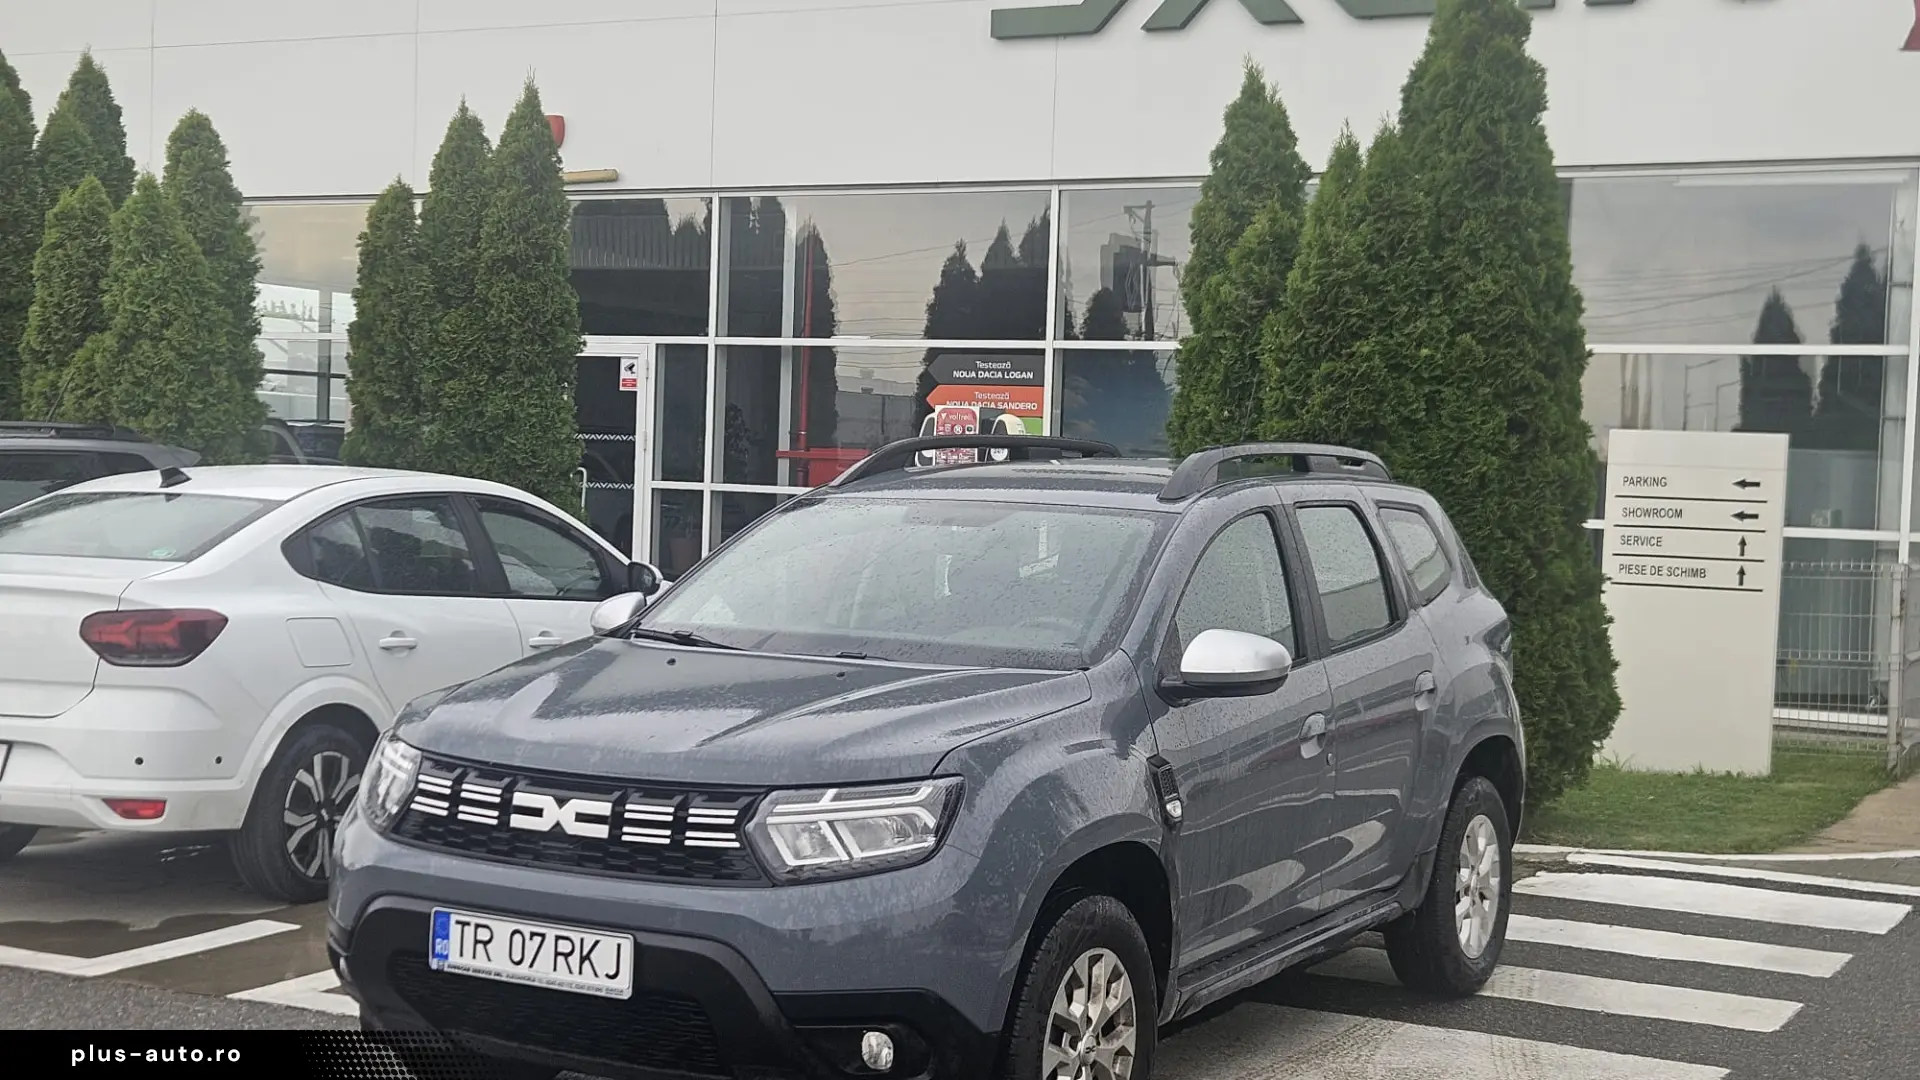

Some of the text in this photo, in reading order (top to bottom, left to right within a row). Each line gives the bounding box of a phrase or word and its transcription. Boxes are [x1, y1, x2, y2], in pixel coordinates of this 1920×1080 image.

[953, 370, 976, 378] NOUA
[1004, 371, 1034, 379] LOGAN
[997, 402, 1038, 410] SANDERO
[1622, 476, 1668, 488] PARKING
[1621, 507, 1683, 519] SHOWROOM
[1620, 534, 1662, 547] SERVICE
[1619, 564, 1707, 579] PIESE DE SCHIMB
[436, 938, 449, 955] RO
[454, 920, 622, 980] TR 07 RKJ
